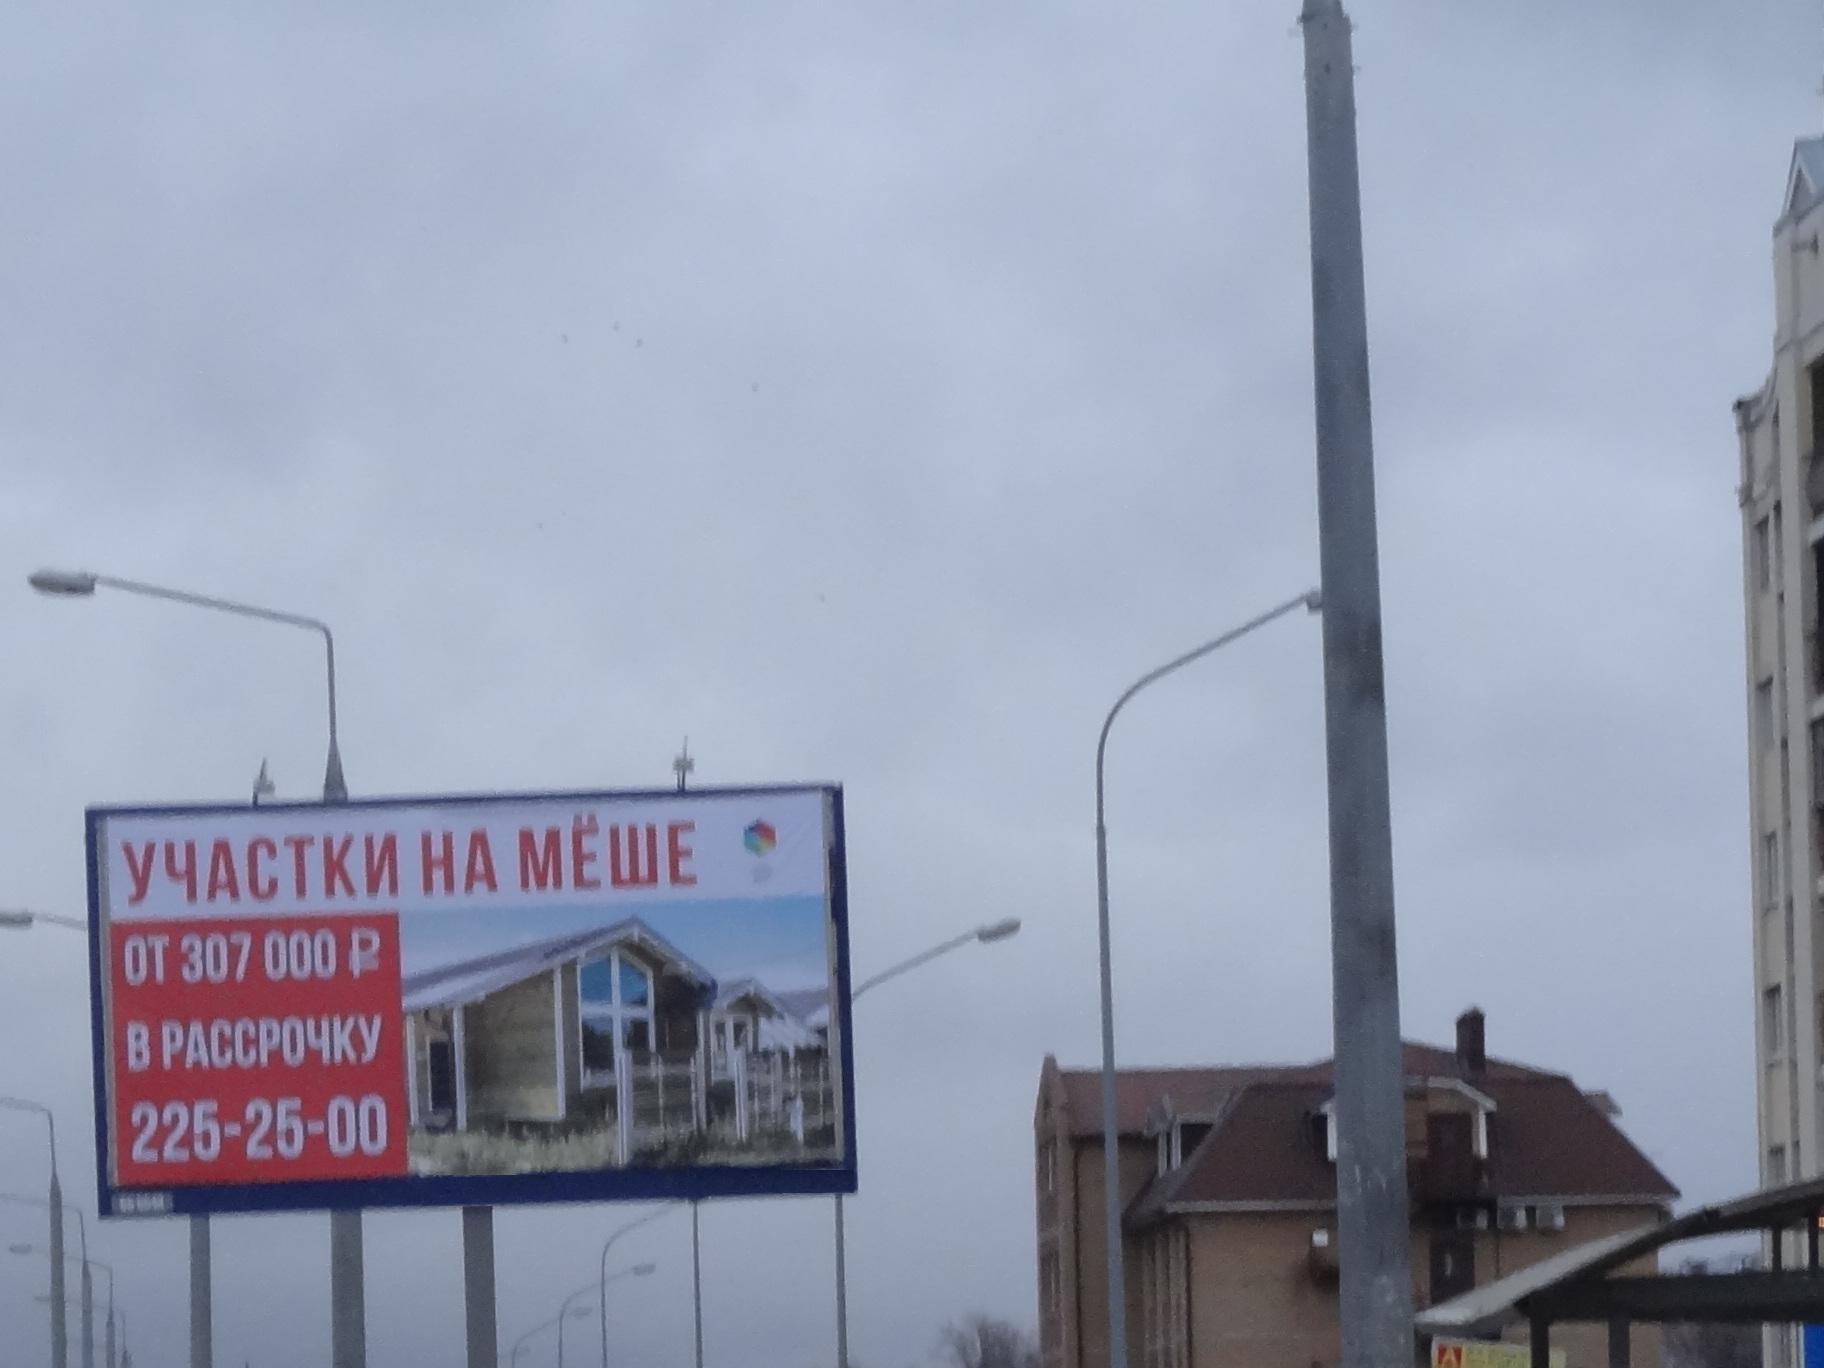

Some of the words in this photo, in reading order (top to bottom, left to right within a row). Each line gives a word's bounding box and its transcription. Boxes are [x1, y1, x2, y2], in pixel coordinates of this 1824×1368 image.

[122, 833, 398, 905] УЧАСТКИ
[421, 827, 498, 895] НА
[519, 811, 697, 892] МЁШЕ
[125, 933, 169, 986] ОТ
[181, 932, 252, 984] 307
[264, 928, 336, 981] 000
[127, 1019, 151, 1072] В
[161, 1013, 381, 1070] РАССРОЧКУ
[131, 1093, 388, 1163] 225-25-00
